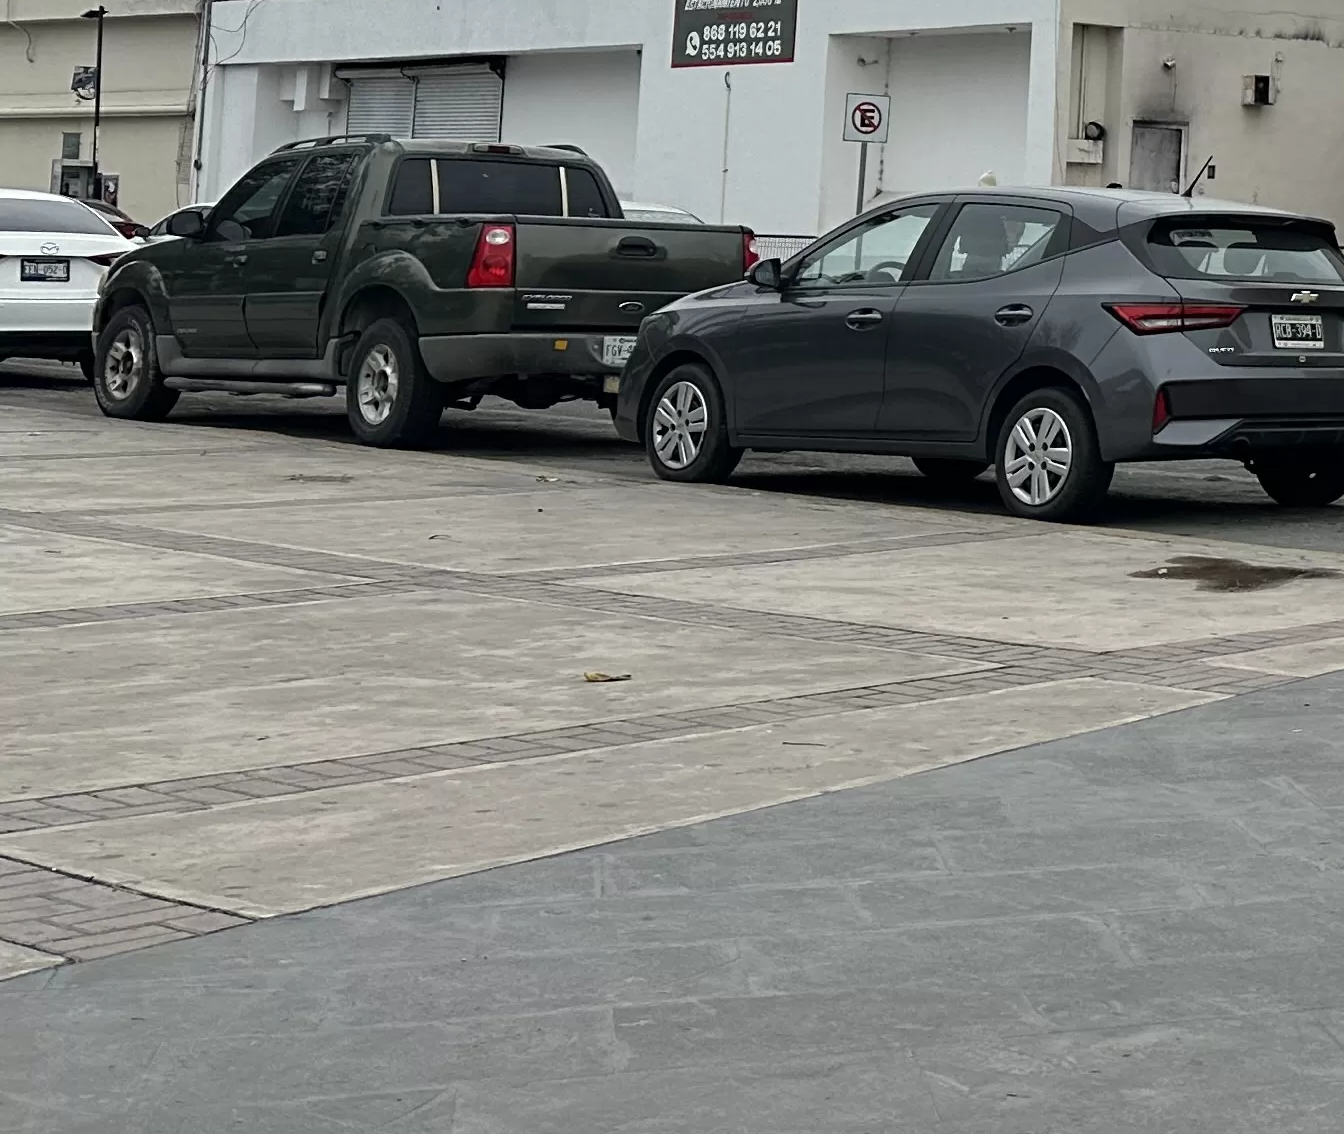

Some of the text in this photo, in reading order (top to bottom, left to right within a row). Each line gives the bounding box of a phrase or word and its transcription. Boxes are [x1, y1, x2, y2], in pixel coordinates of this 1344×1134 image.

[703, 20, 782, 41] 868 119 62 21
[701, 40, 782, 60] 554 913 14 05
[860, 108, 876, 127] E
